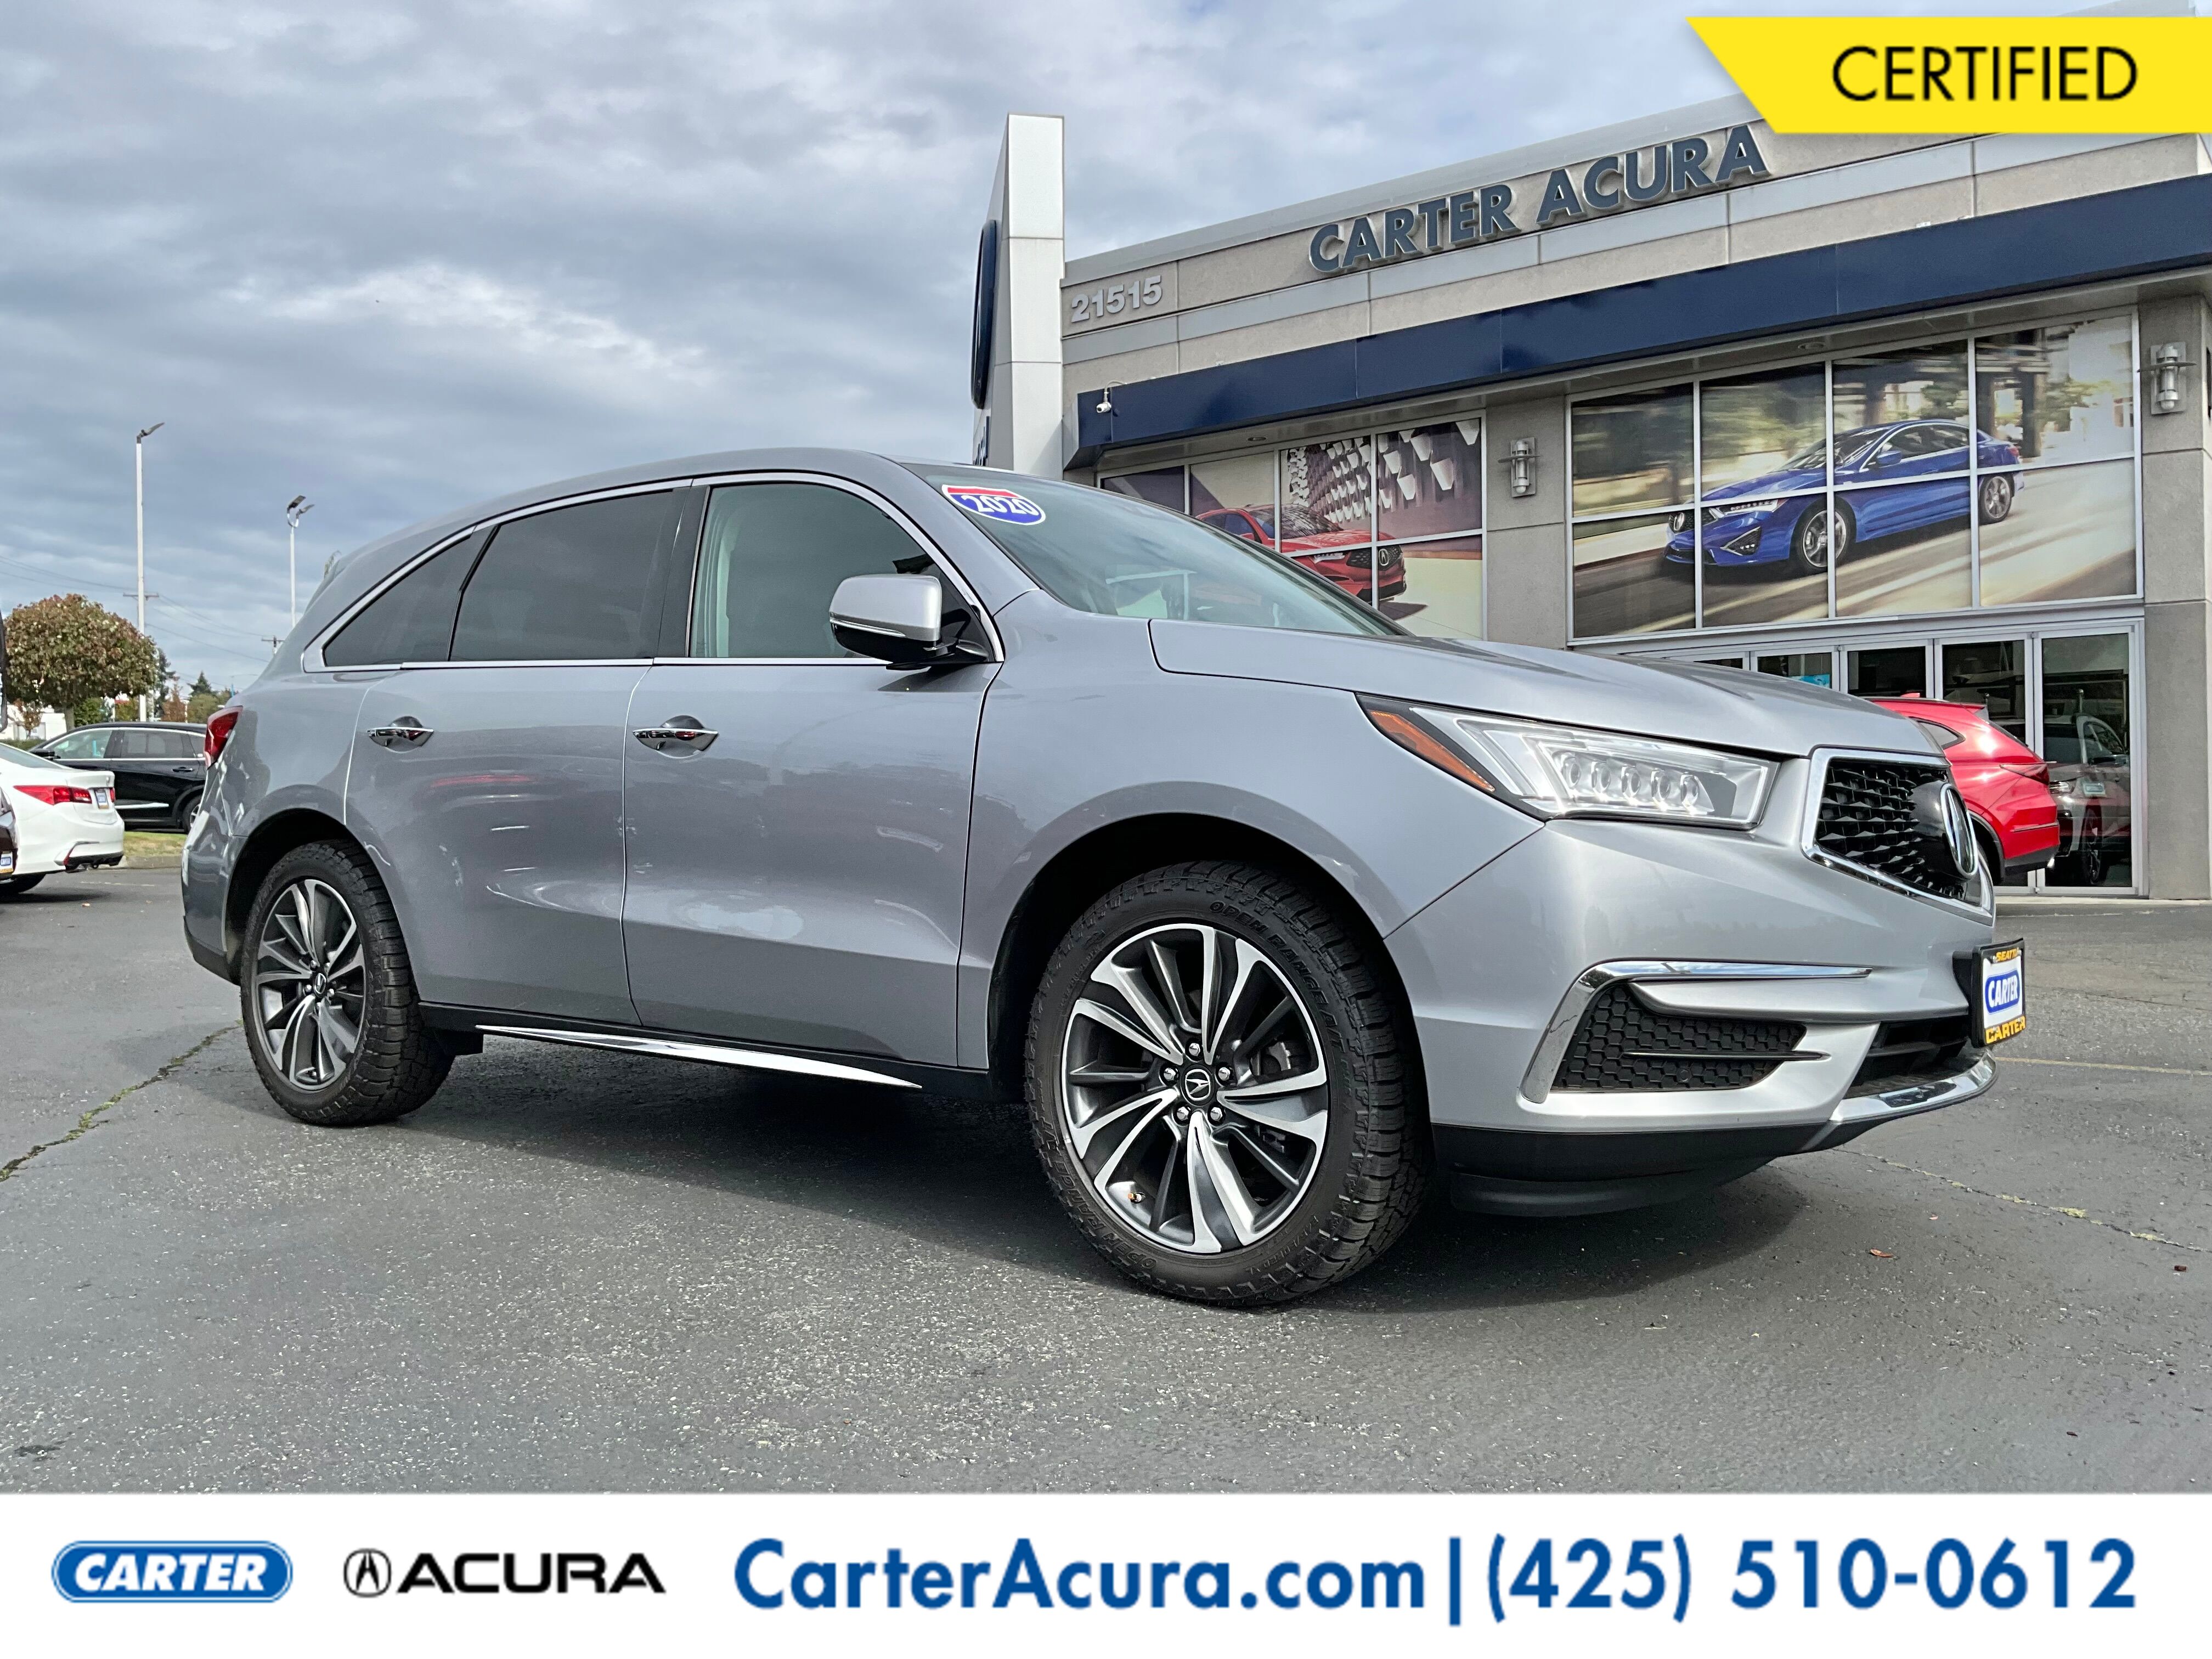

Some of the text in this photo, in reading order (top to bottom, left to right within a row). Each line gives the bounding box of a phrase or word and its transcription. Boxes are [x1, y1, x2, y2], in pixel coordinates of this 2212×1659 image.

[1309, 125, 1770, 273] CARTER ACURA
[1071, 275, 1162, 323] 21515
[961, 495, 1039, 516] 2020
[1988, 975, 2018, 1008] CARTER
[1986, 1015, 2025, 1043] CARTER
